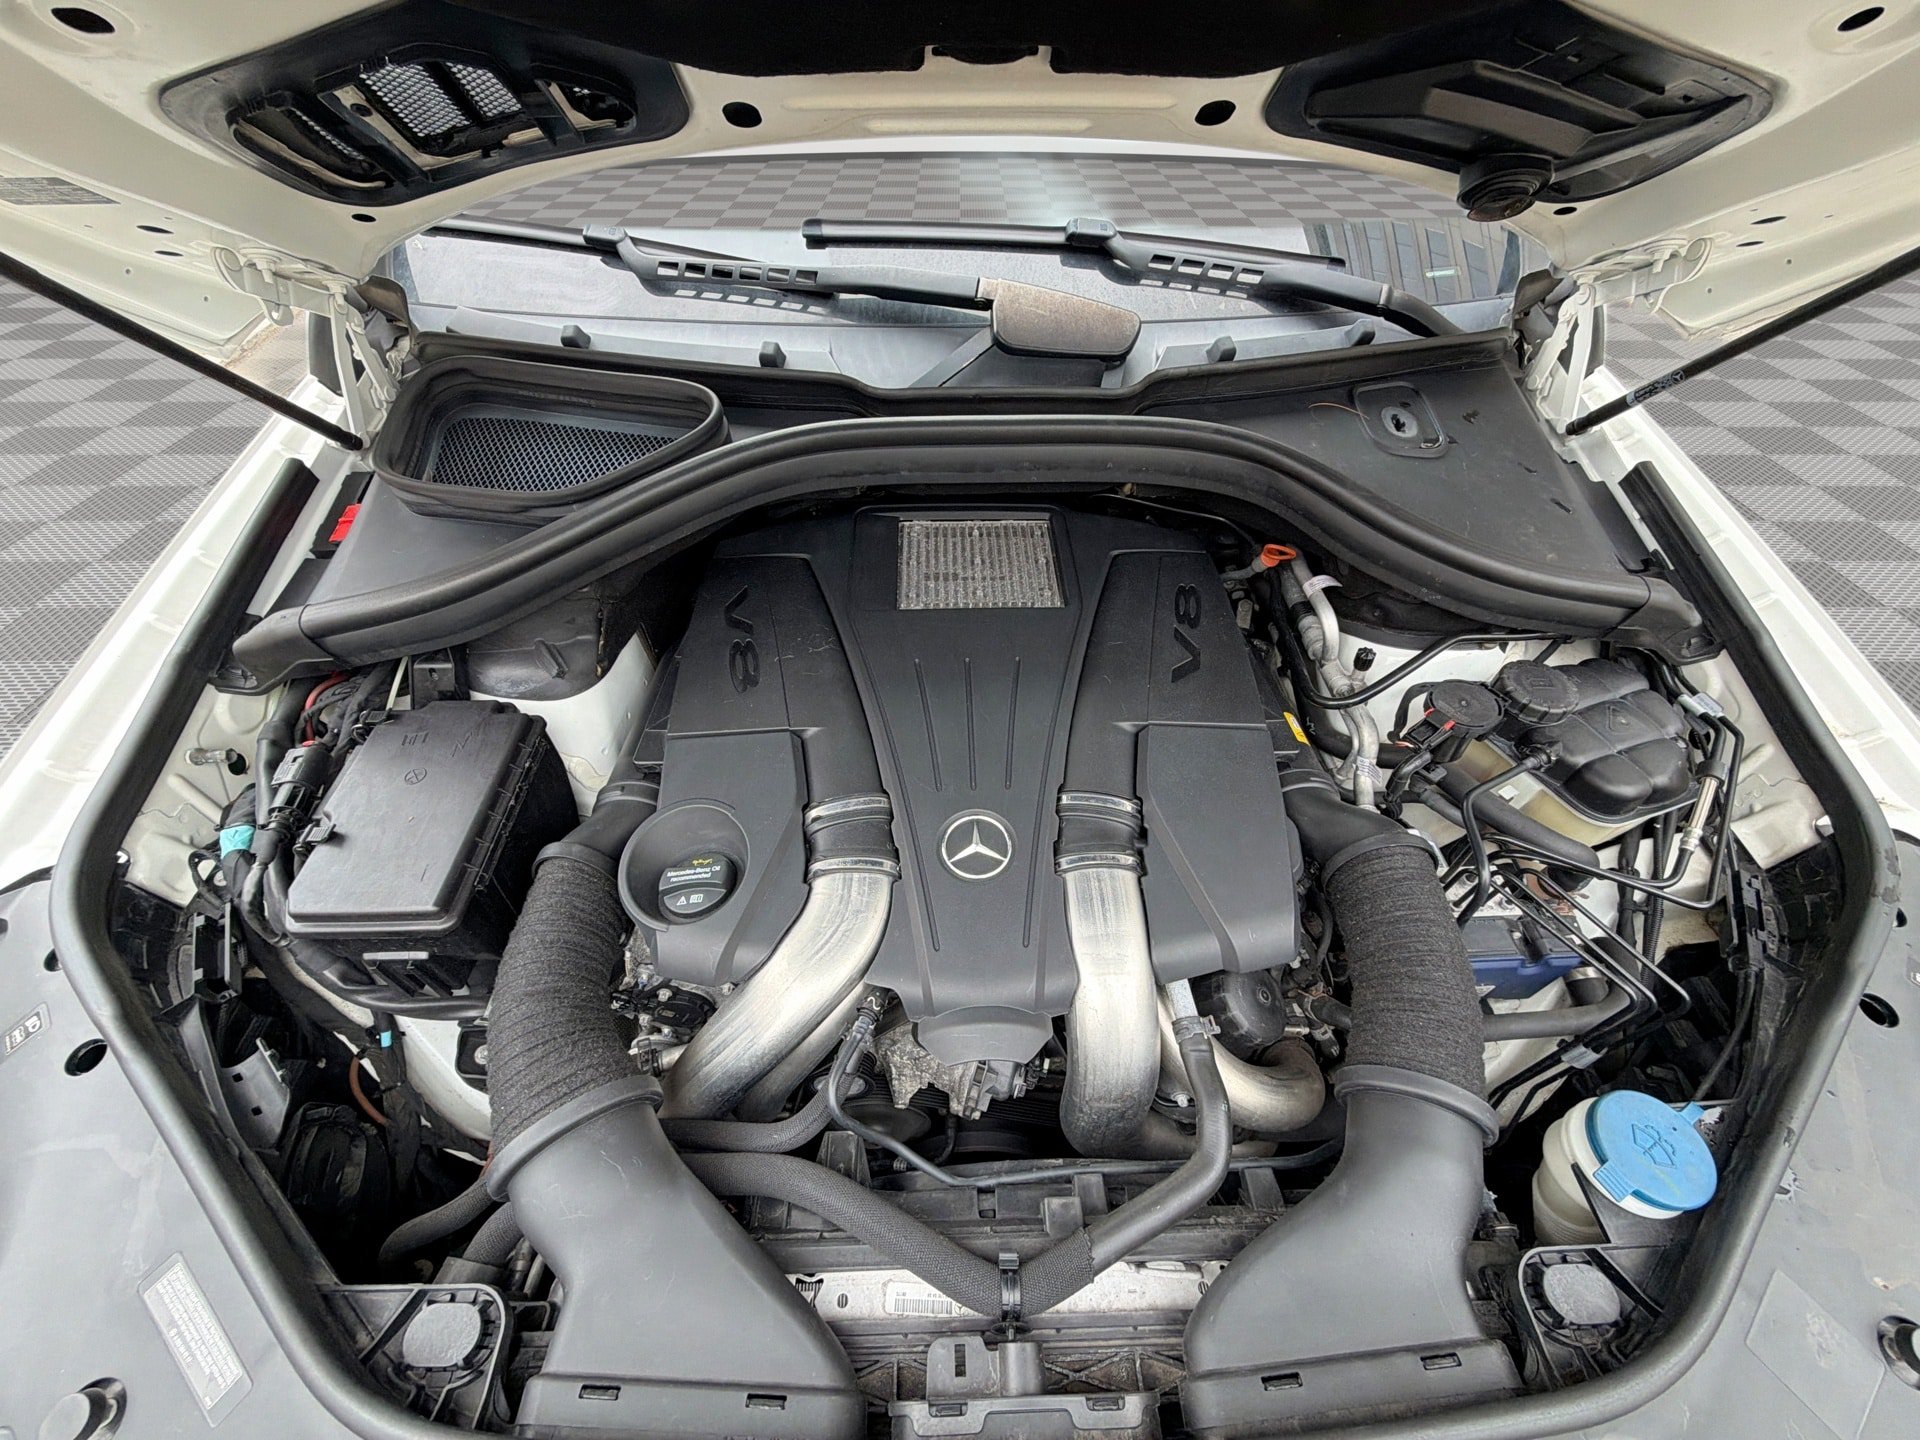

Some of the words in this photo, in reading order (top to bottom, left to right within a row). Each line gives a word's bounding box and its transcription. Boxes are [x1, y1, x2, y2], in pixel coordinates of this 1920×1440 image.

[724, 585, 760, 693] V8
[1171, 583, 1201, 683] V8
[666, 867, 711, 877] Mercedes-Benz
[670, 872, 711, 882] recommended
